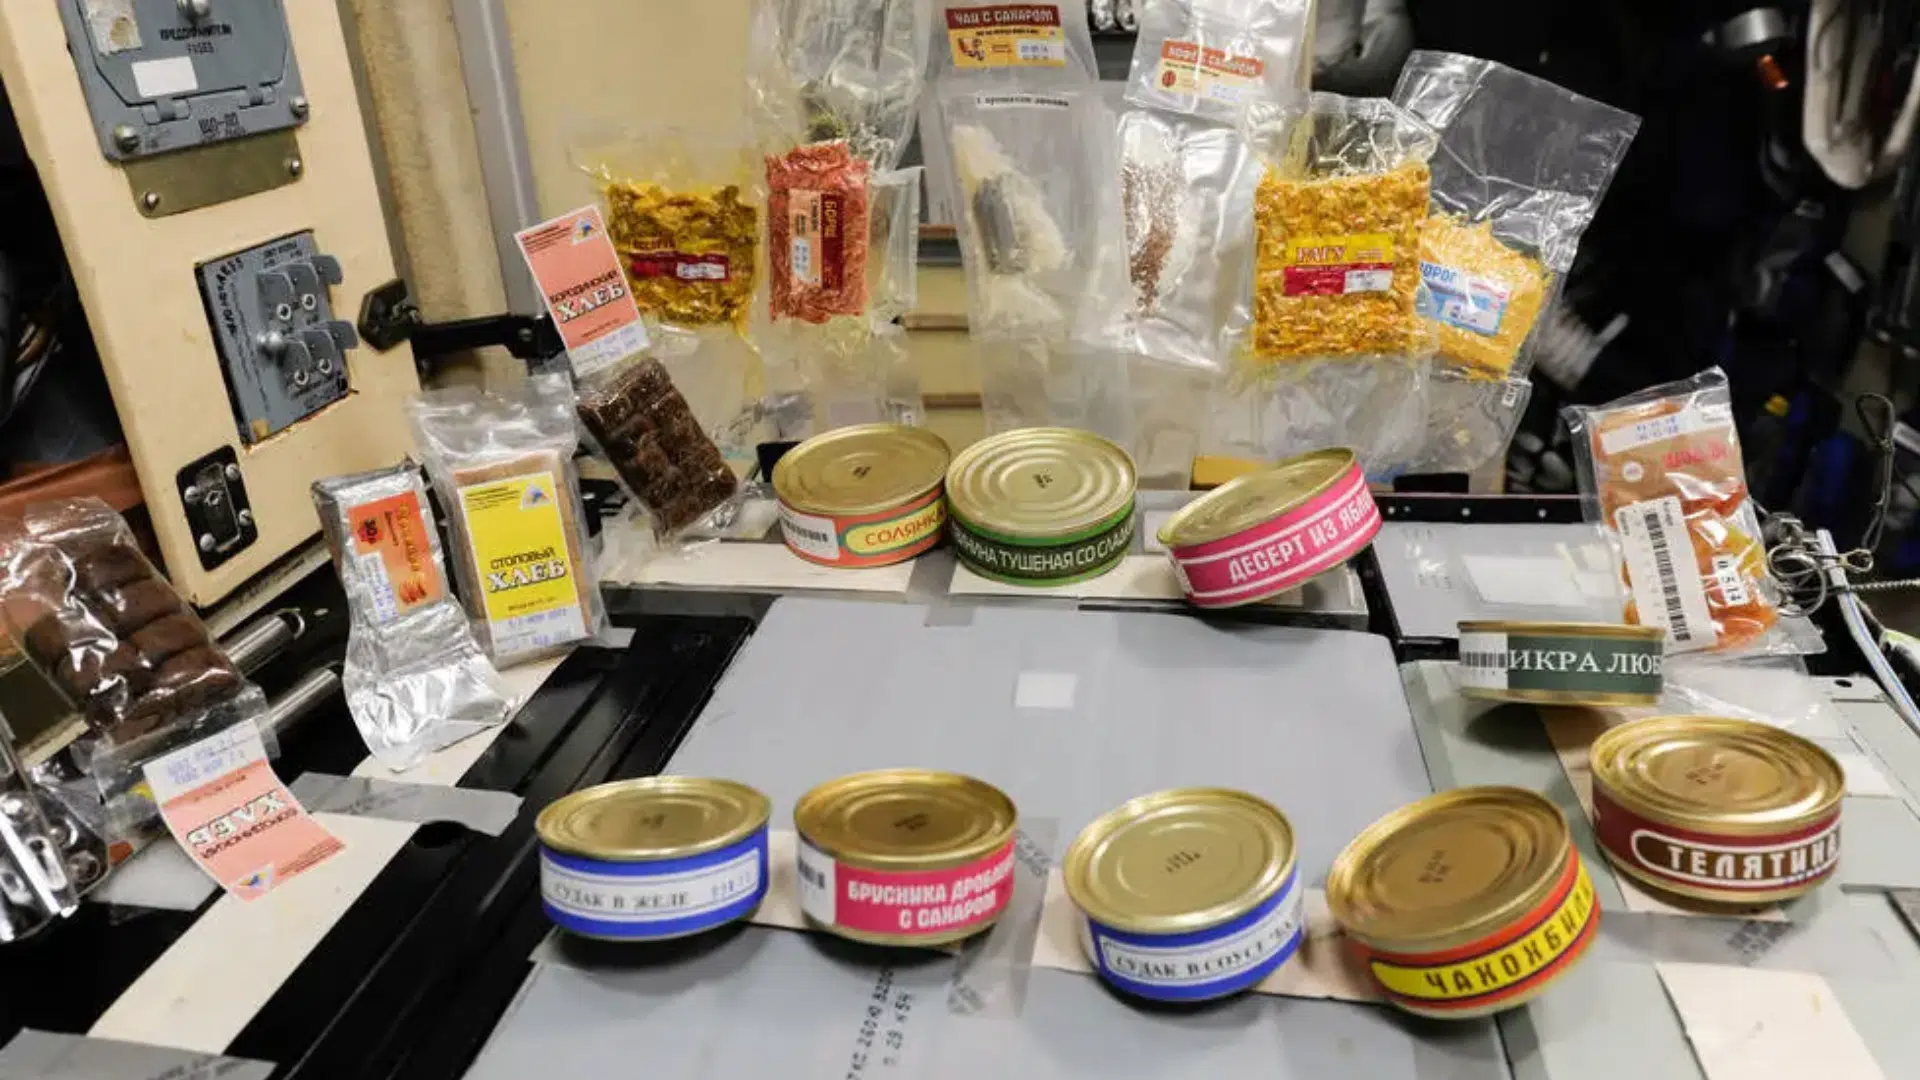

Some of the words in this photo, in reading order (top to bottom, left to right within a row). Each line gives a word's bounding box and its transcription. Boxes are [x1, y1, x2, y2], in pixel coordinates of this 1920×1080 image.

[556, 283, 625, 324] ХЛЕБ
[999, 550, 1074, 572] ТУШЕНАЯ
[1075, 545, 1097, 565] СО
[1228, 534, 1306, 584] ДЕСЕРТ
[1308, 518, 1339, 549] ИЗ
[487, 559, 566, 593] ХЛЕБ
[1509, 649, 1601, 673] ИКРА
[186, 787, 288, 848] ХЛЕБ
[1667, 826, 1841, 879] ТЕЛЯТИНА
[554, 883, 602, 906] СУДАК
[847, 880, 947, 906] БРУСНИКА
[899, 910, 912, 929] С
[917, 889, 996, 928] САХАРОМ
[1115, 956, 1178, 977] СУДАК
